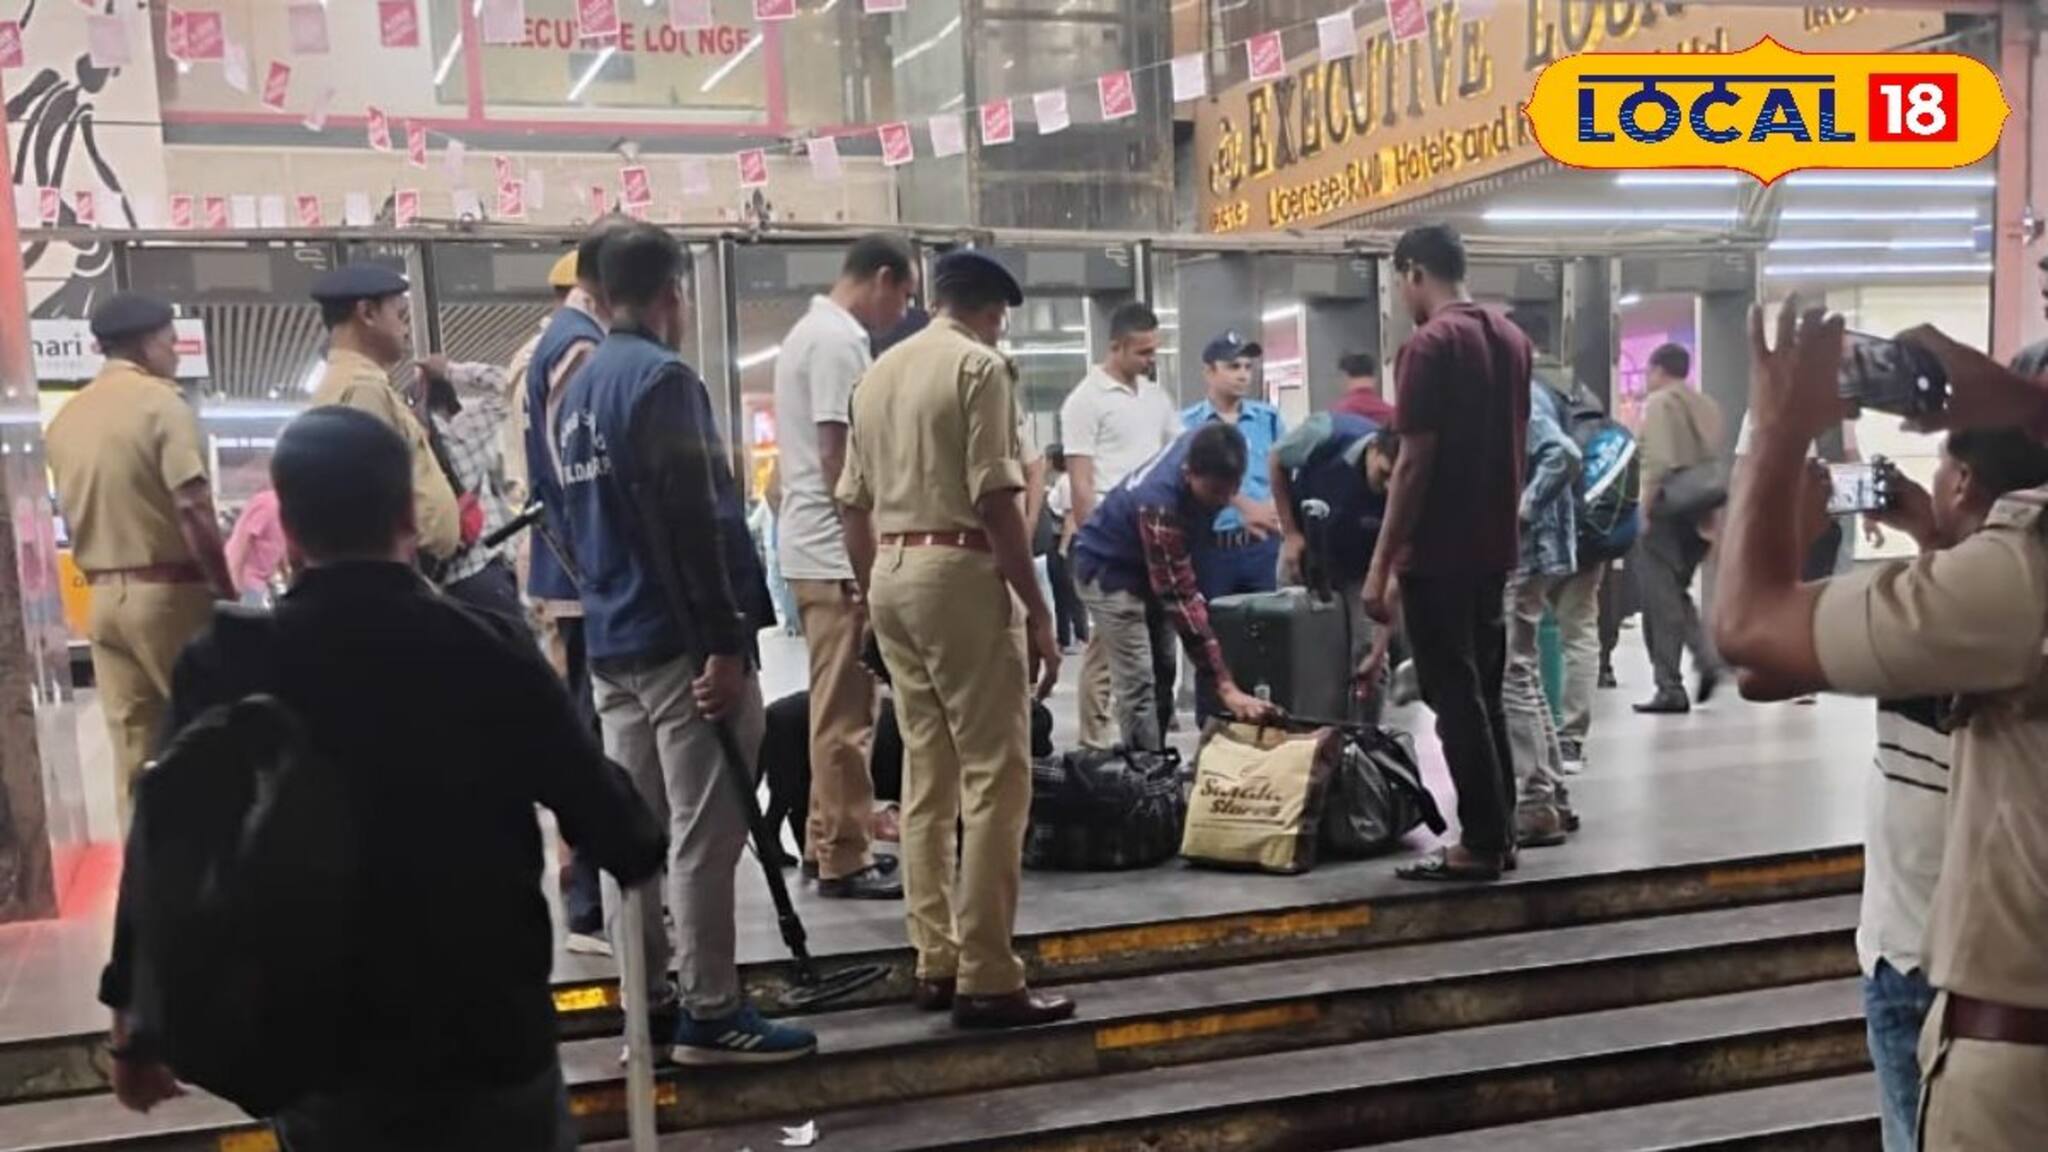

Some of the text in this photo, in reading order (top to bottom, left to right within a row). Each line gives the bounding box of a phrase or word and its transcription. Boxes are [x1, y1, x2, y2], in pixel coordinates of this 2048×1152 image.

[1246, 4, 1491, 180] EXECUTIVE
[1394, 131, 1460, 188] Hotels
[1464, 104, 1513, 163] and
